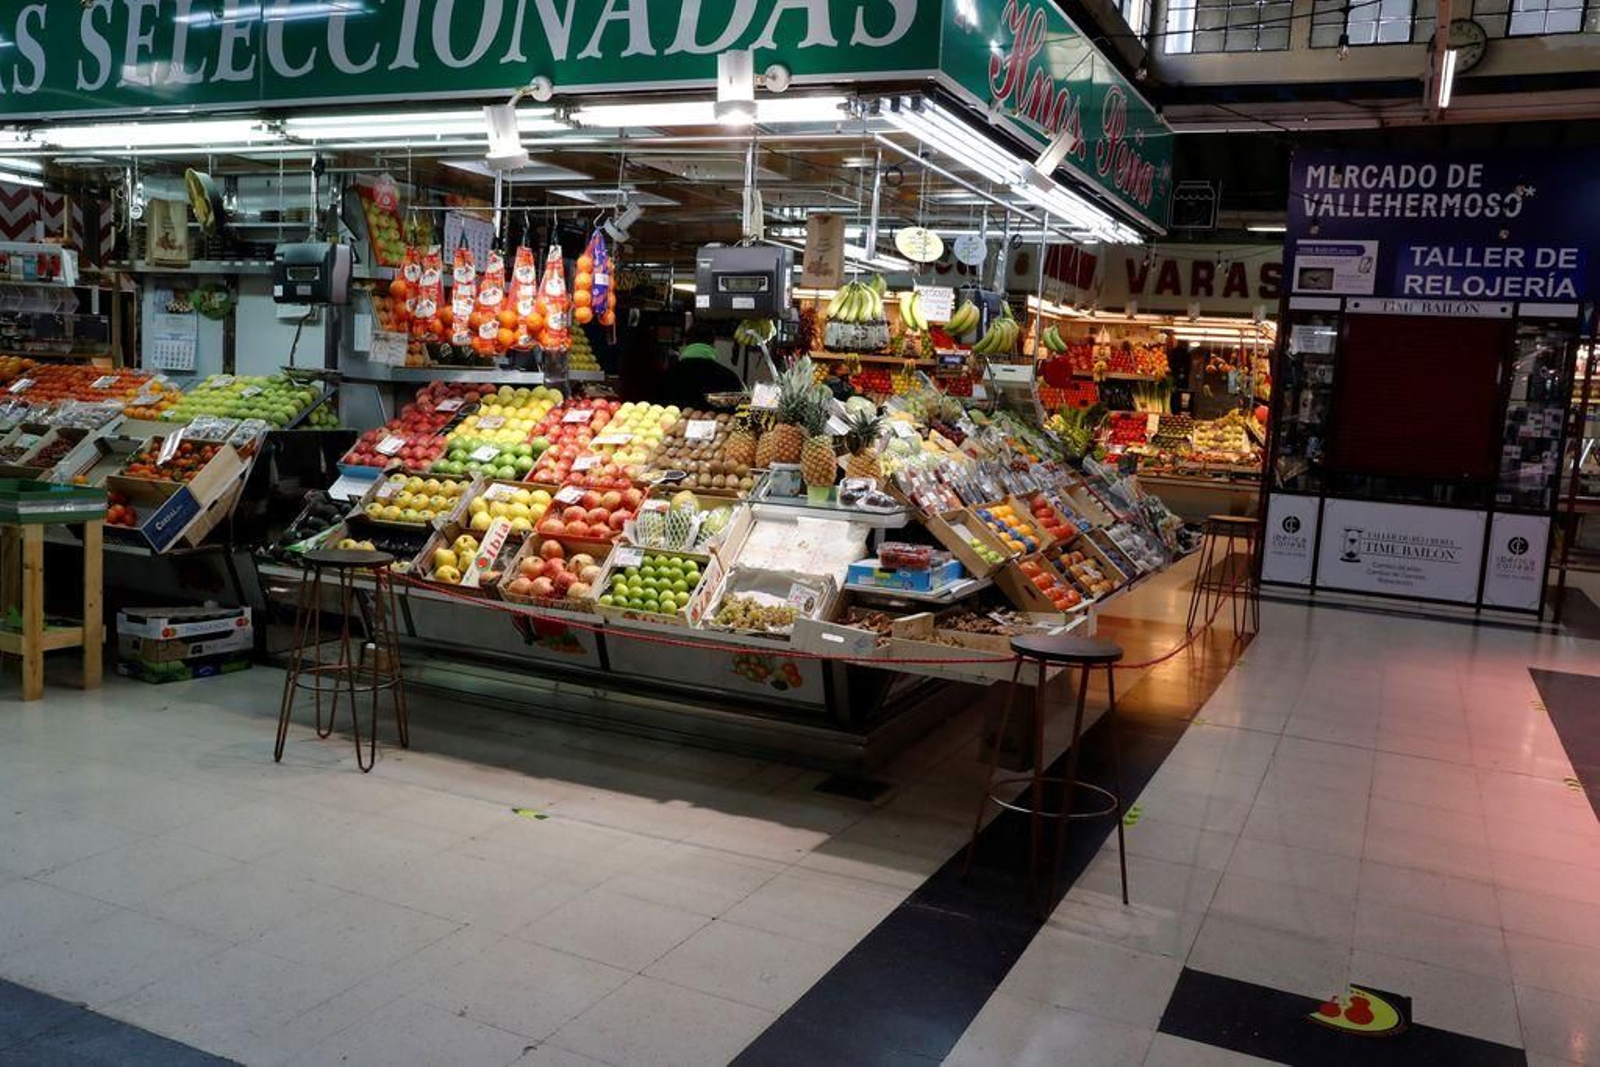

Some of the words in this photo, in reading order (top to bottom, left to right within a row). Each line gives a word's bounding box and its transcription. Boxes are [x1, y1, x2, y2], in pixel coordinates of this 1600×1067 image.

[1447, 163, 1484, 189] DE
[1303, 193, 1523, 218] VALLEHERMOSO
[1410, 246, 1525, 268] TALLER
[1535, 247, 1579, 269] DE
[1125, 258, 1284, 300] VARAS
[1403, 272, 1578, 298] RELOJERÍA
